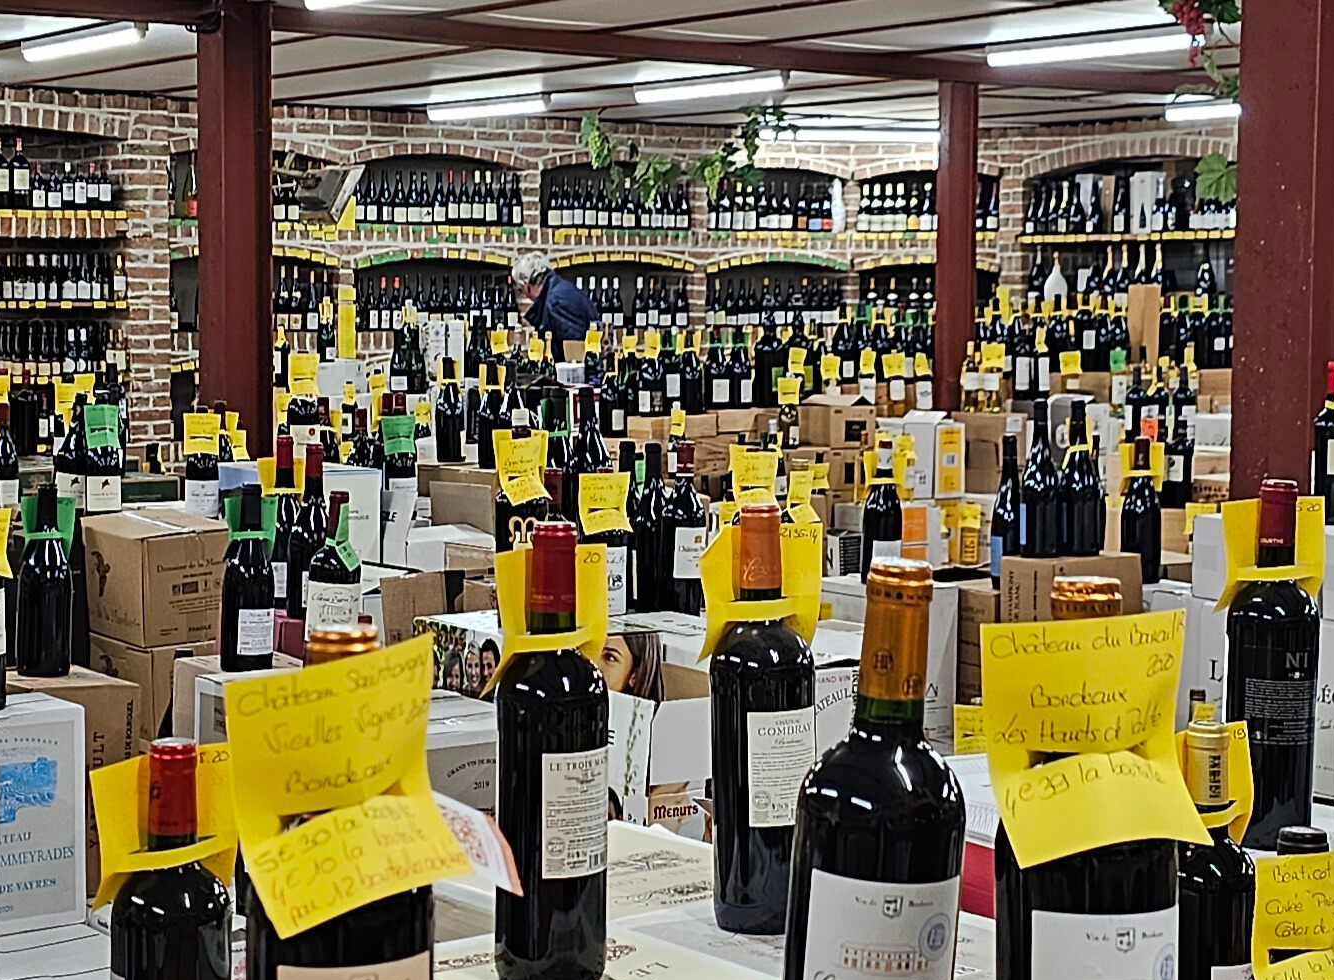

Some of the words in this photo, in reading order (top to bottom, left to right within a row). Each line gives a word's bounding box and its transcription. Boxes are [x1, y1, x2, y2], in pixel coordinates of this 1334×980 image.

[582, 552, 601, 563] 20
[990, 626, 1082, 659] Château
[1091, 625, 1121, 647] du
[1029, 681, 1129, 709] Bordeaux
[549, 762, 563, 772] LE
[1079, 763, 1102, 783] la
[474, 780, 490, 790] 2019
[16, 877, 56, 892] VAYRES
